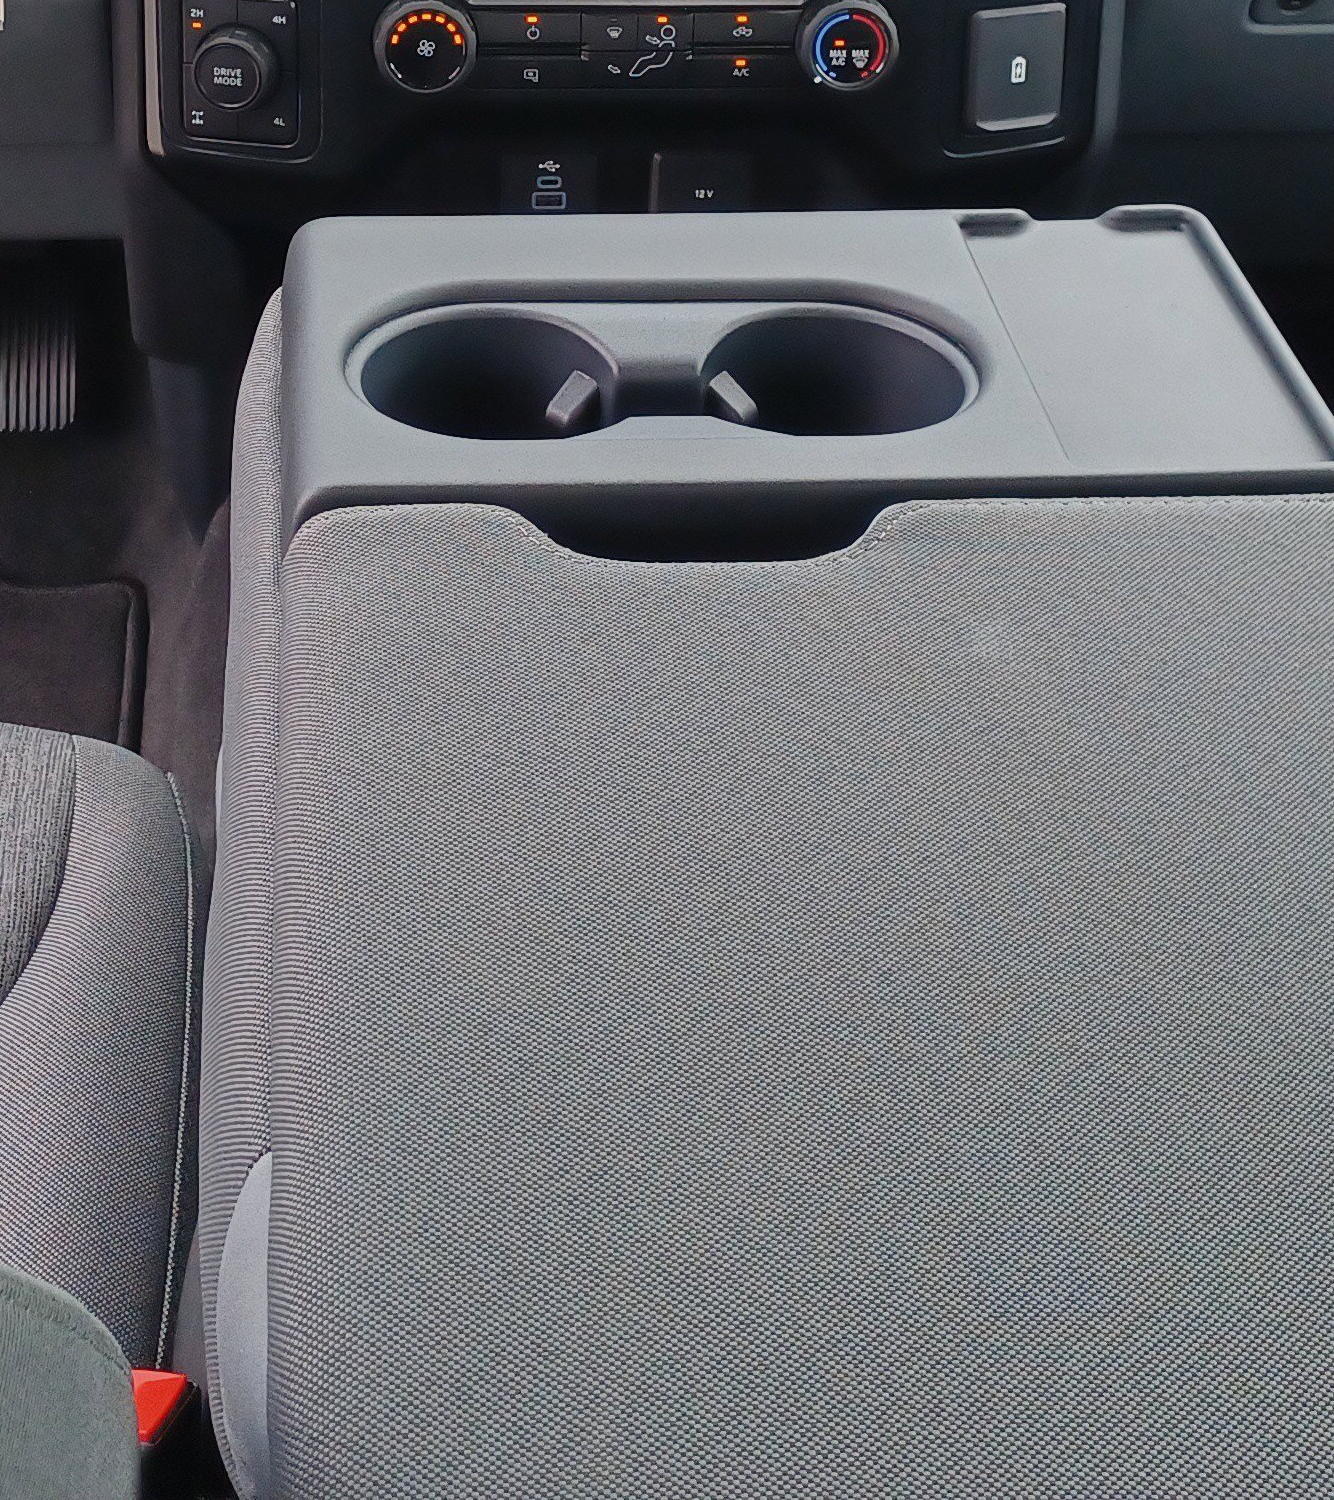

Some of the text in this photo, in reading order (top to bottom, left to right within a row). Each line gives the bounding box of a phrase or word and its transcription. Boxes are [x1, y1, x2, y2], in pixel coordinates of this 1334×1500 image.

[190, 8, 204, 18] 2H
[272, 15, 287, 25] 4H
[829, 50, 847, 58] MAX
[851, 50, 869, 58] MAX
[831, 58, 846, 66] A/C
[213, 66, 242, 78] DRIVE
[733, 68, 749, 78] A/C
[213, 76, 243, 88] MODE
[273, 116, 285, 126] 4L
